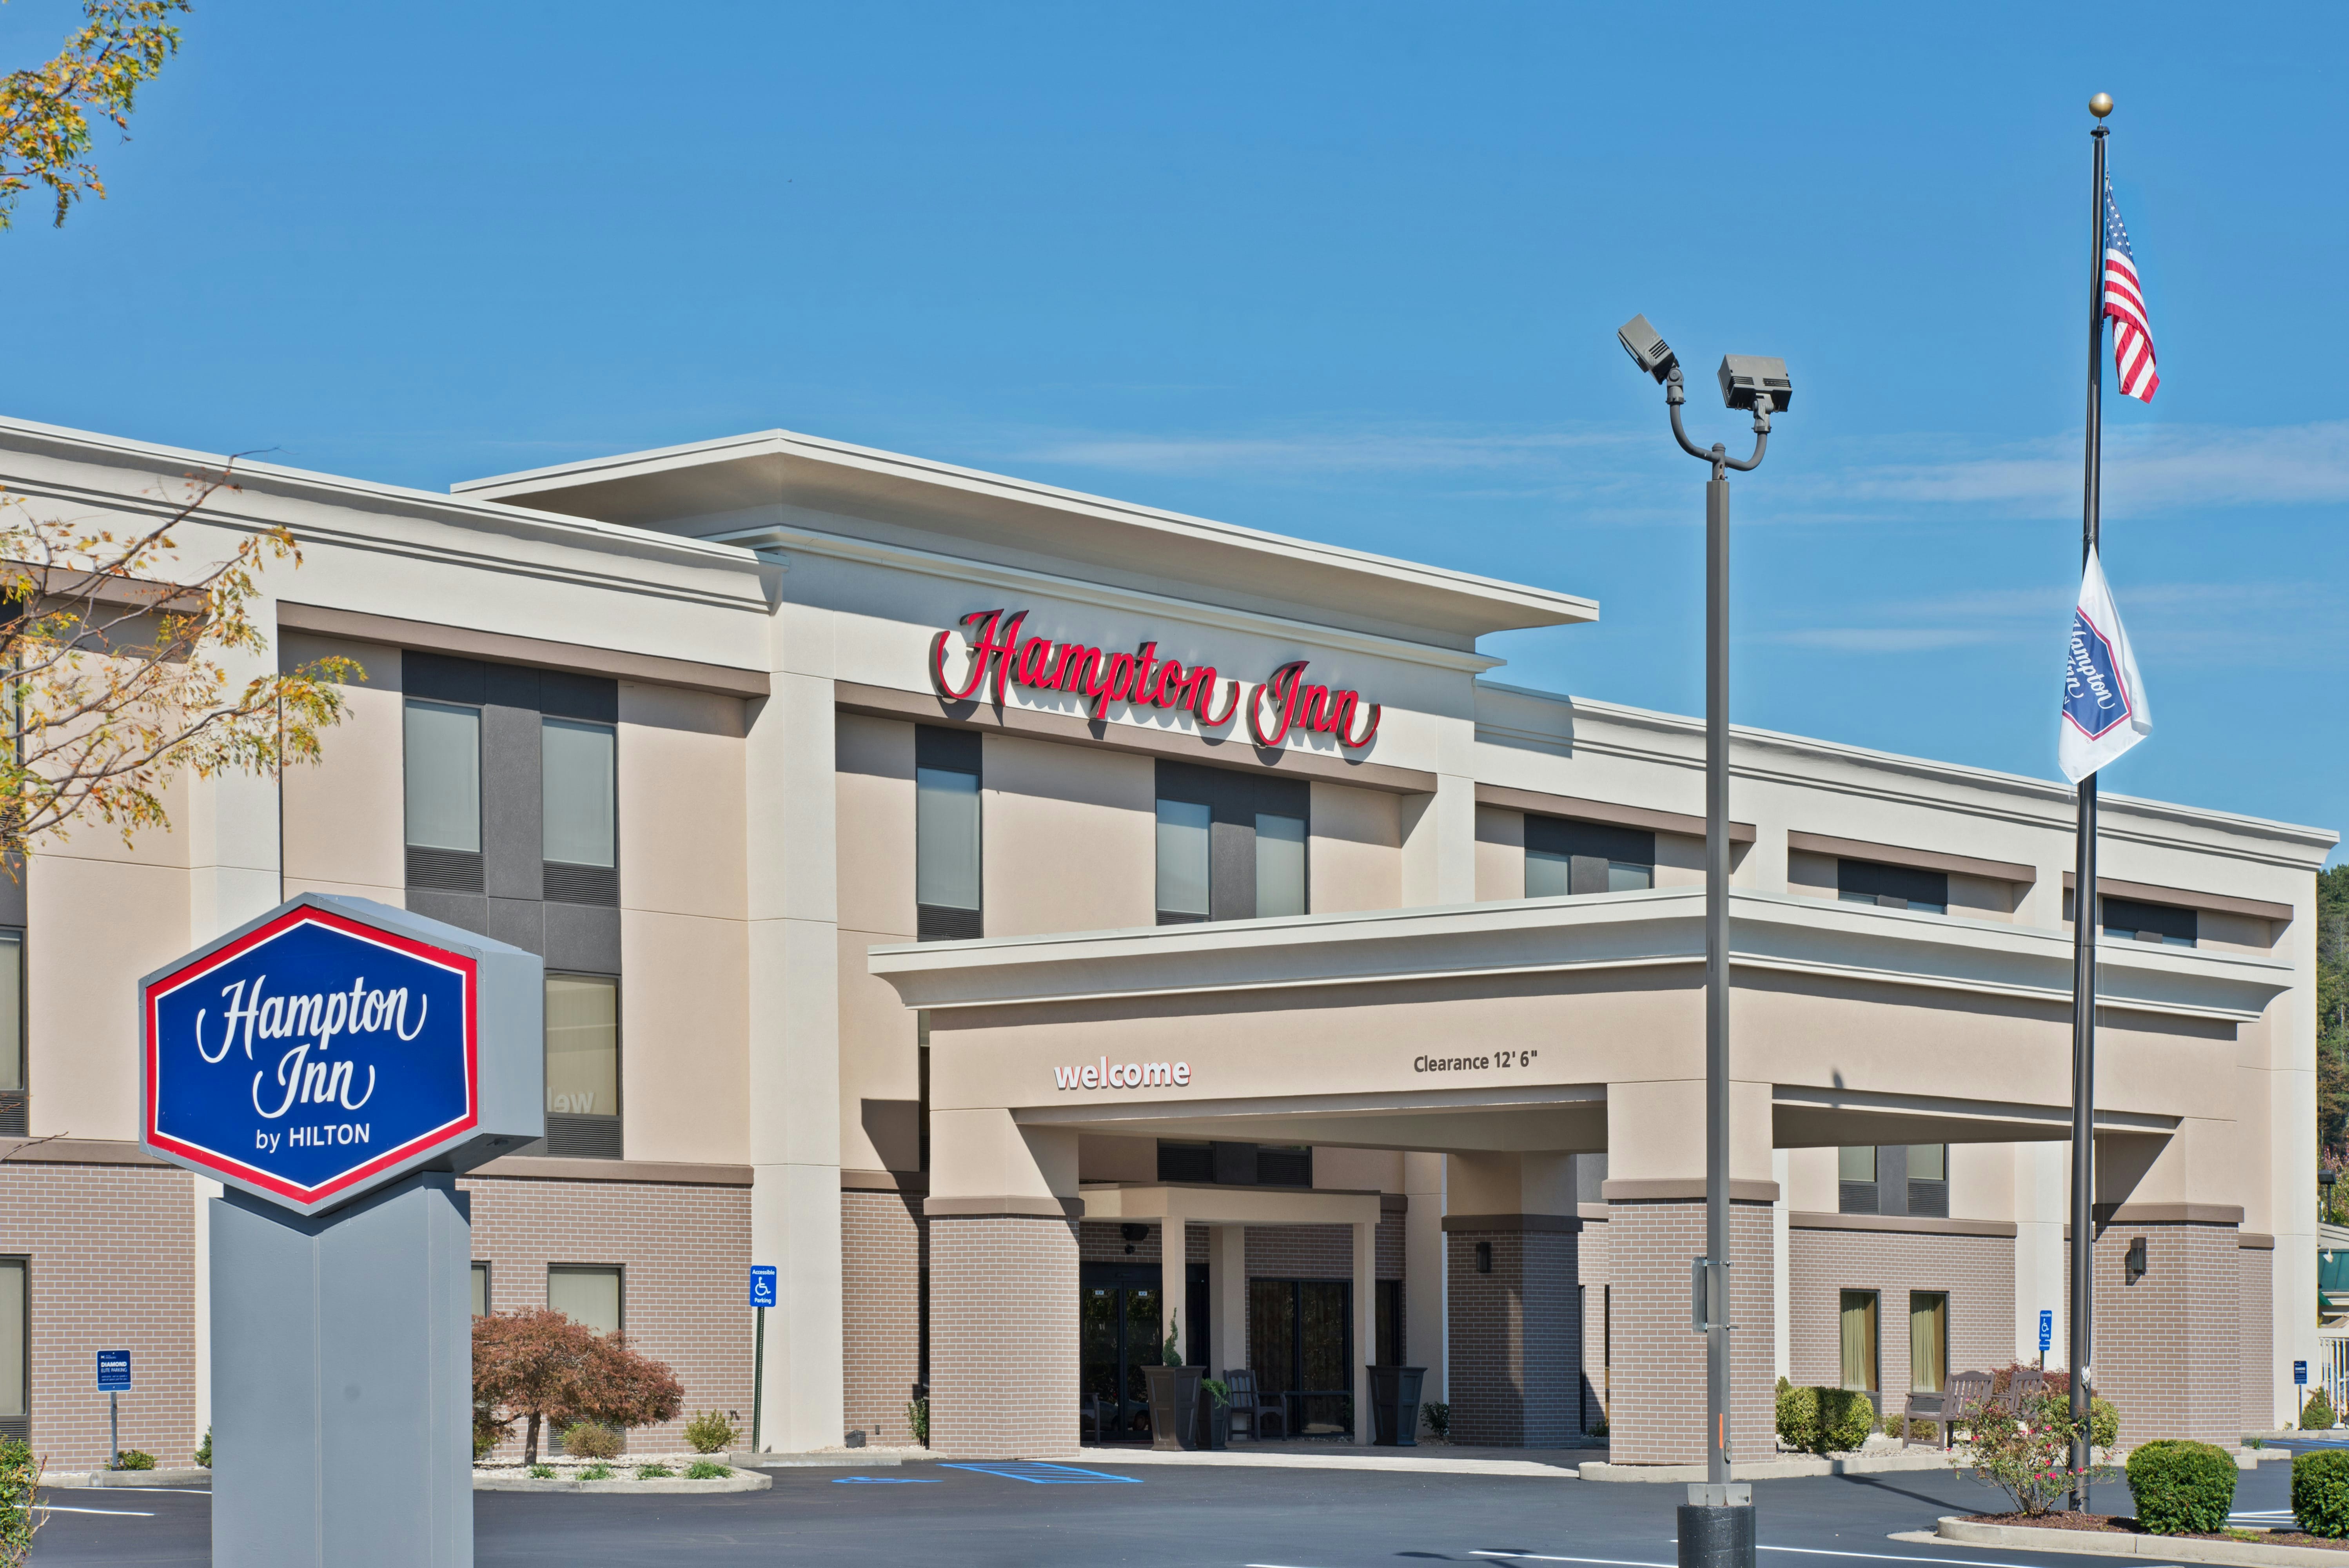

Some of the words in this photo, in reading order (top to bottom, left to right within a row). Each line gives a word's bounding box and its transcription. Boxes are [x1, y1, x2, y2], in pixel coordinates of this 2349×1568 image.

[930, 608, 1240, 728] Hampton
[1251, 661, 1381, 748] Inn
[196, 975, 427, 1063] Hampton
[252, 1043, 376, 1119] Inn
[1054, 1056, 1191, 1090] welcome
[1414, 1055, 1489, 1073] Clearance
[1494, 1051, 1516, 1068] 12'
[1520, 1050, 1538, 1067] 6"
[256, 1129, 281, 1153] by
[289, 1123, 370, 1147] HILTON
